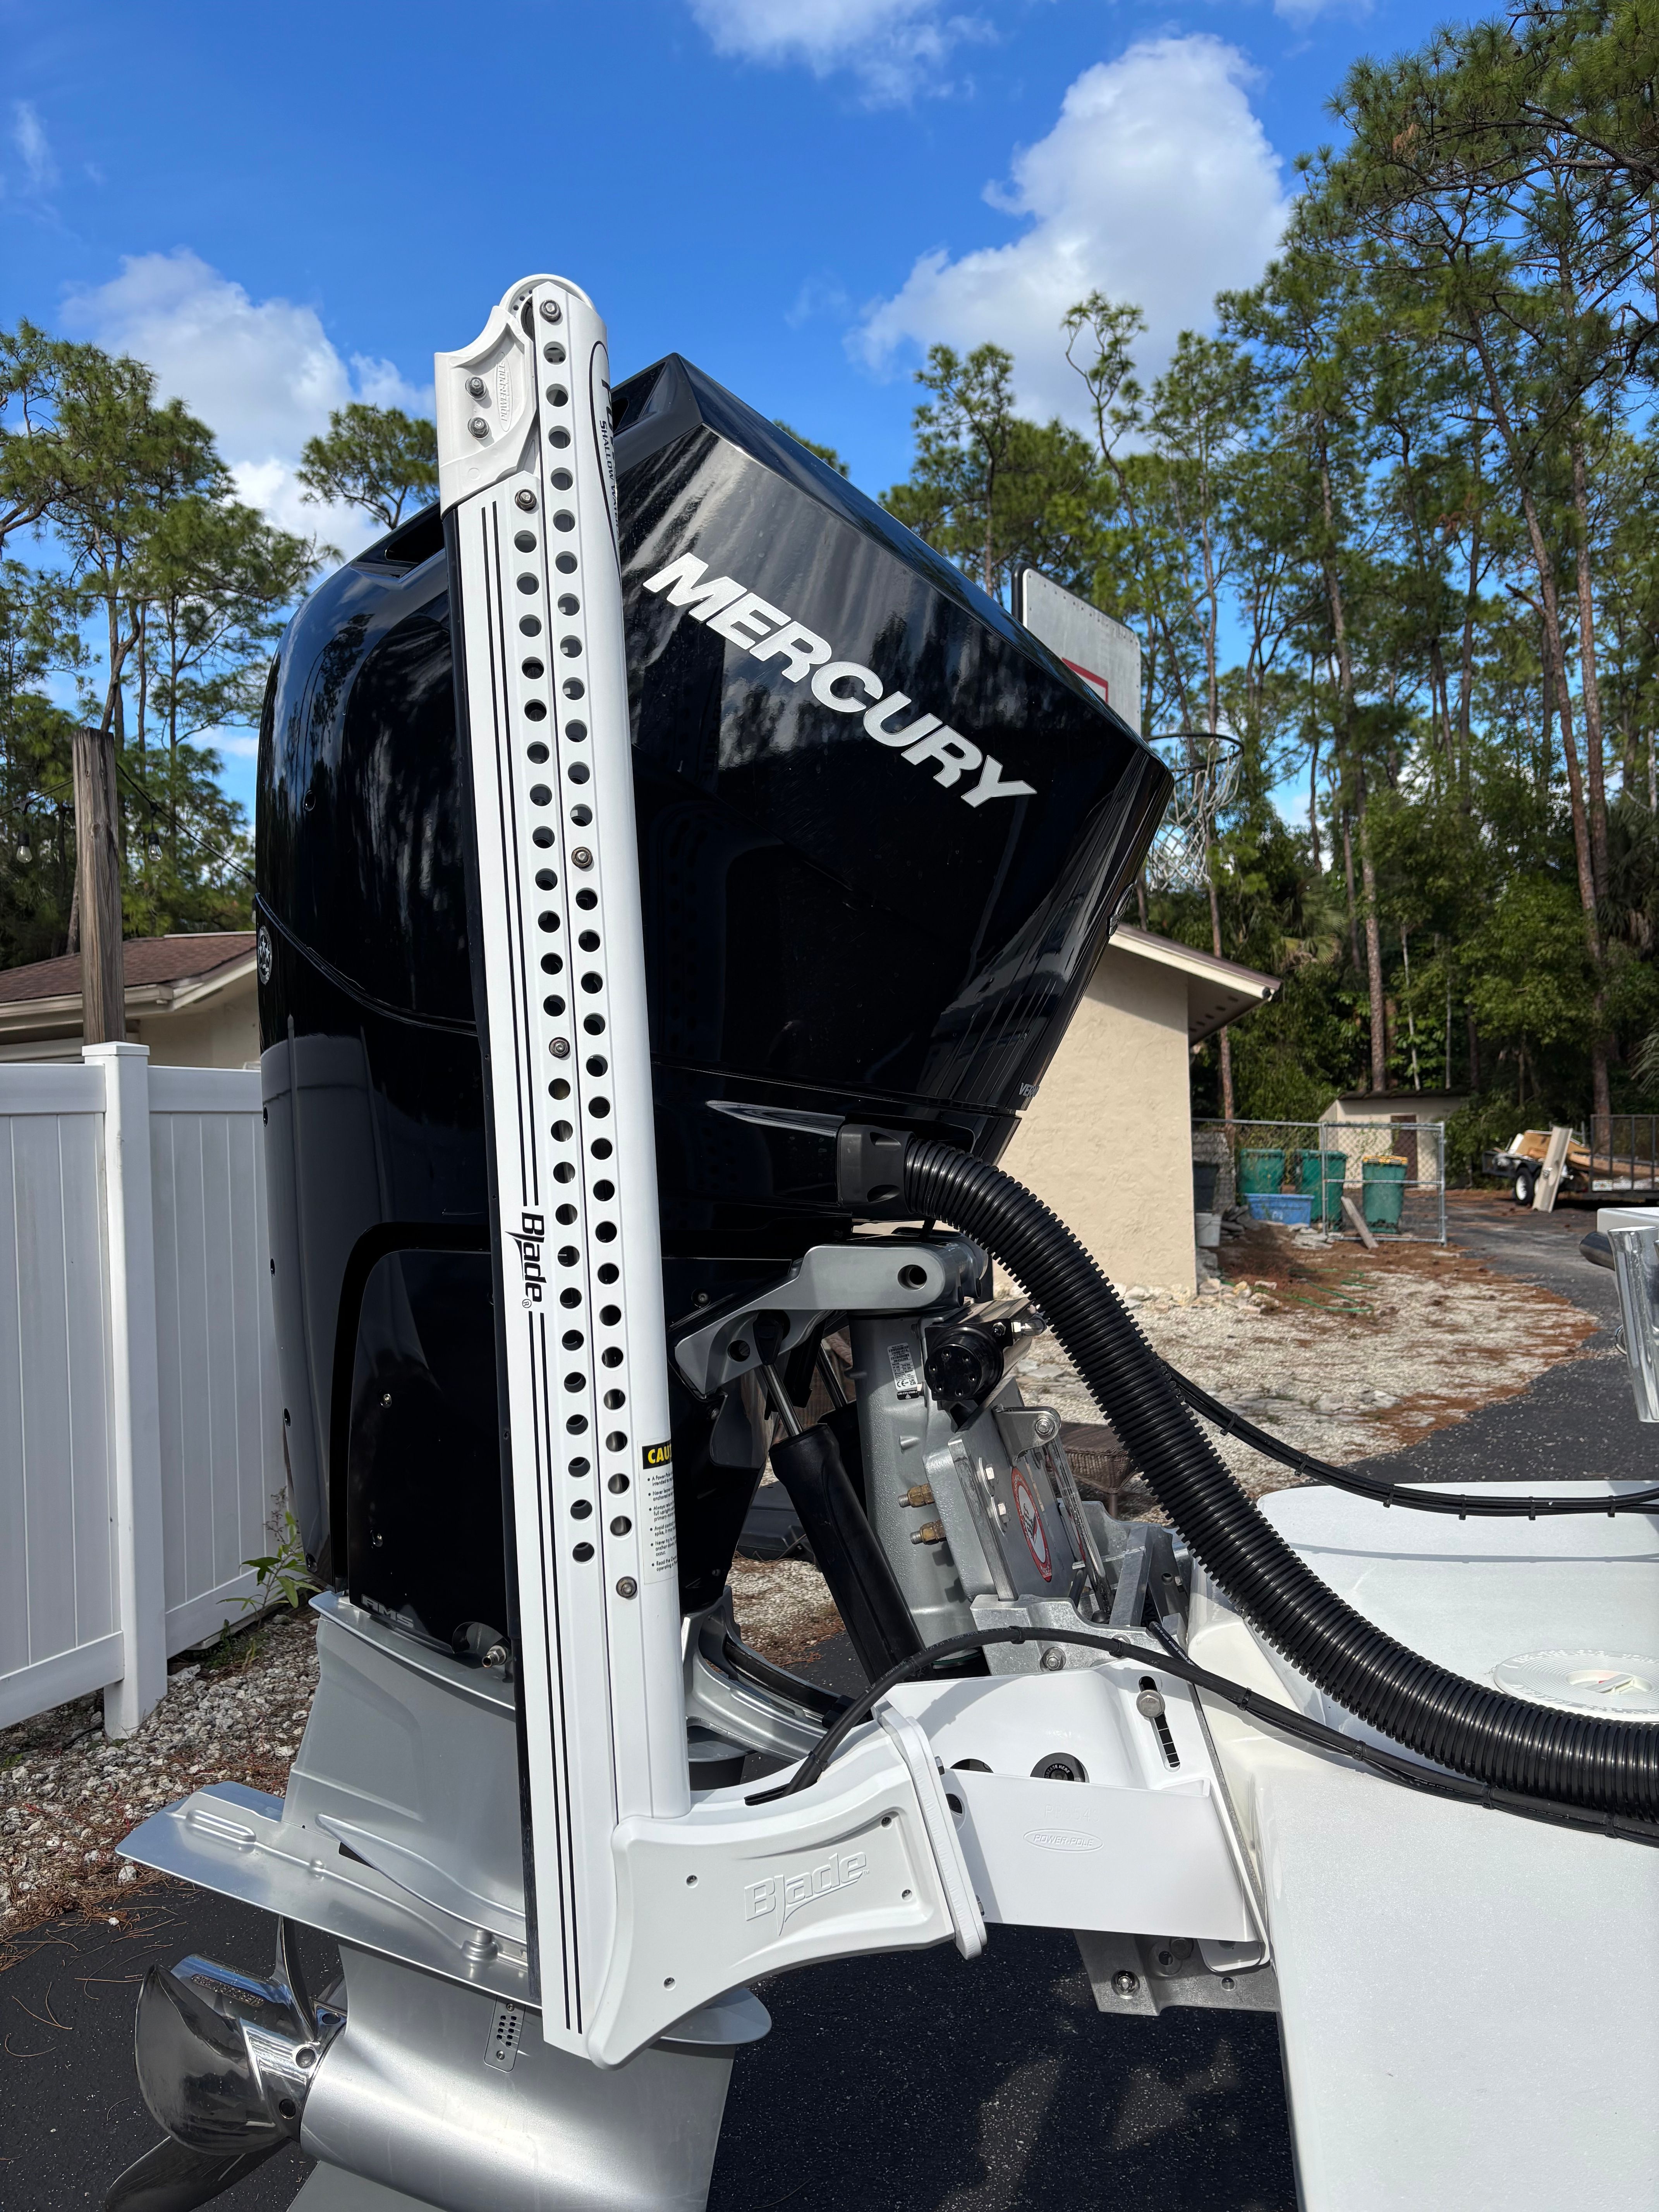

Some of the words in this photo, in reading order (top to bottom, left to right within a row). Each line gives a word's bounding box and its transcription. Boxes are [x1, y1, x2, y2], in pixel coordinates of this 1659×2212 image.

[599, 420, 614, 481] SHALLOW
[642, 552, 1037, 808] MERCURY
[361, 1594, 414, 1628] AMS
[1059, 1765, 1070, 1774] HERE
[1034, 1834, 1094, 1847] POWER-POLE
